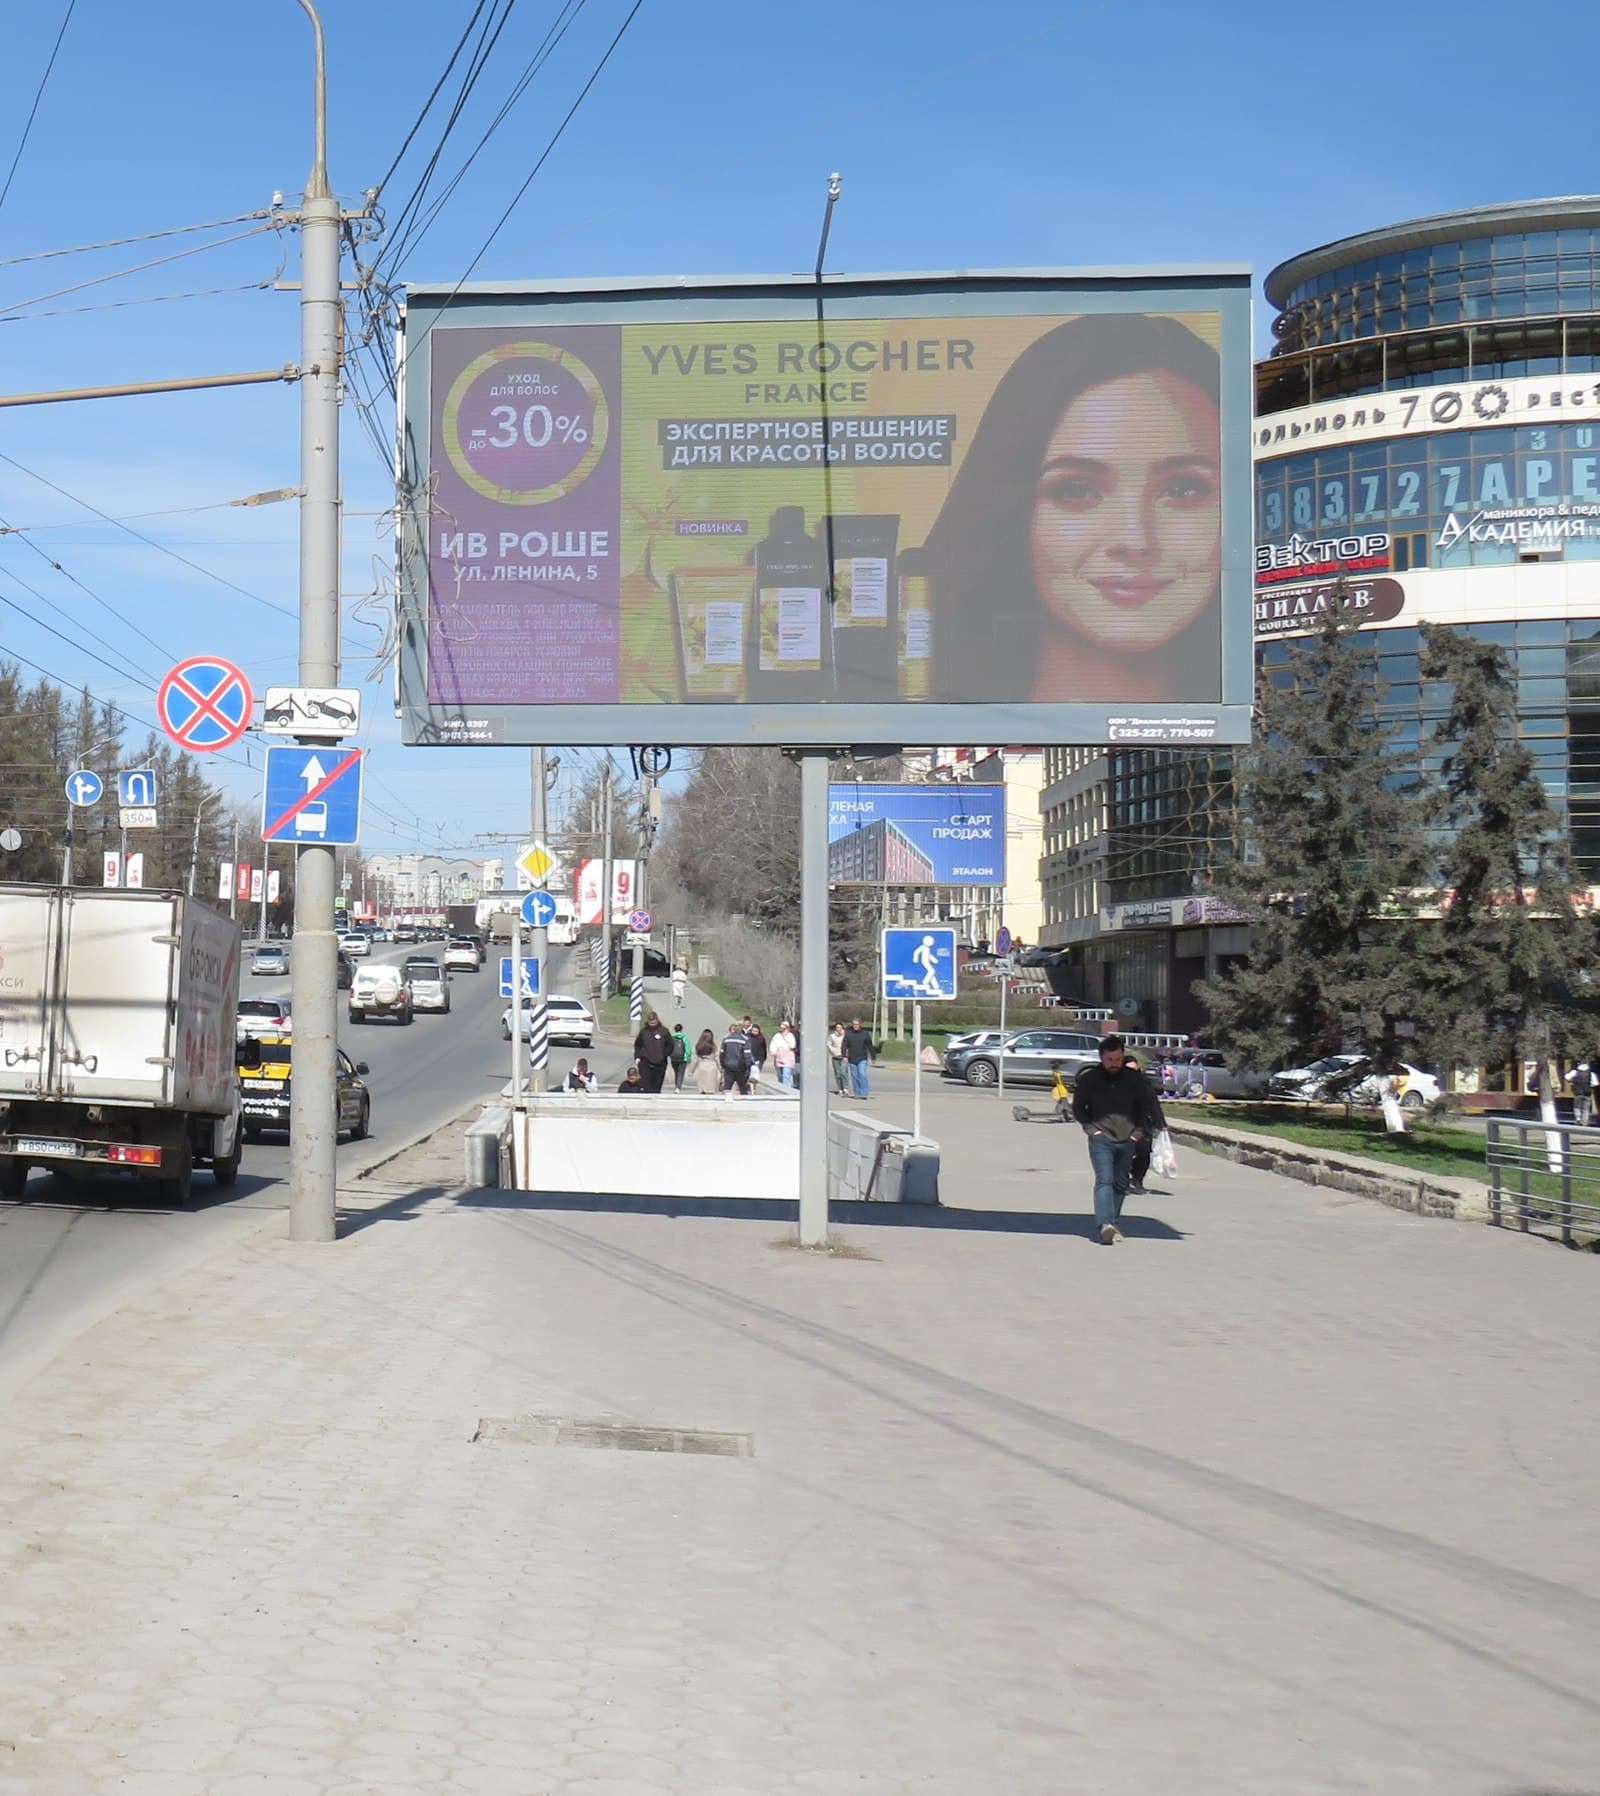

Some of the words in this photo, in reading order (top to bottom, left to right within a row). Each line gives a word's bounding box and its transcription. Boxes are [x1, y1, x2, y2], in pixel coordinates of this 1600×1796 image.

[642, 343, 758, 376] YVES
[777, 339, 976, 374] ROCHER
[507, 374, 541, 384] УХОД
[490, 387, 515, 397] ДЛЯ
[517, 385, 560, 396] ВОЛОС
[745, 381, 867, 405] FRANCE
[666, 421, 824, 442] ЭКСПЕРТНОЕ
[831, 419, 949, 439] РЕШЕНИЕ
[468, 439, 487, 450] ДО
[671, 445, 722, 466] ДЛЯ
[730, 443, 846, 463] КРАСОТЫ
[854, 441, 943, 461] ВОЛОС
[1483, 506, 1555, 520] маникюра
[679, 523, 744, 534] НОВИНКА
[440, 532, 488, 559] ИВ
[499, 530, 609, 558] РОШЕ
[454, 565, 487, 582] УЛ.
[491, 564, 582, 582] ЛЕНИНА,
[586, 564, 598, 580] 5
[1118, 728, 1167, 739] 325-227,
[1169, 728, 1216, 738] 770-507
[932, 828, 993, 841] ПРОДАЖ
[107, 860, 116, 877] 9
[617, 871, 631, 895] 9
